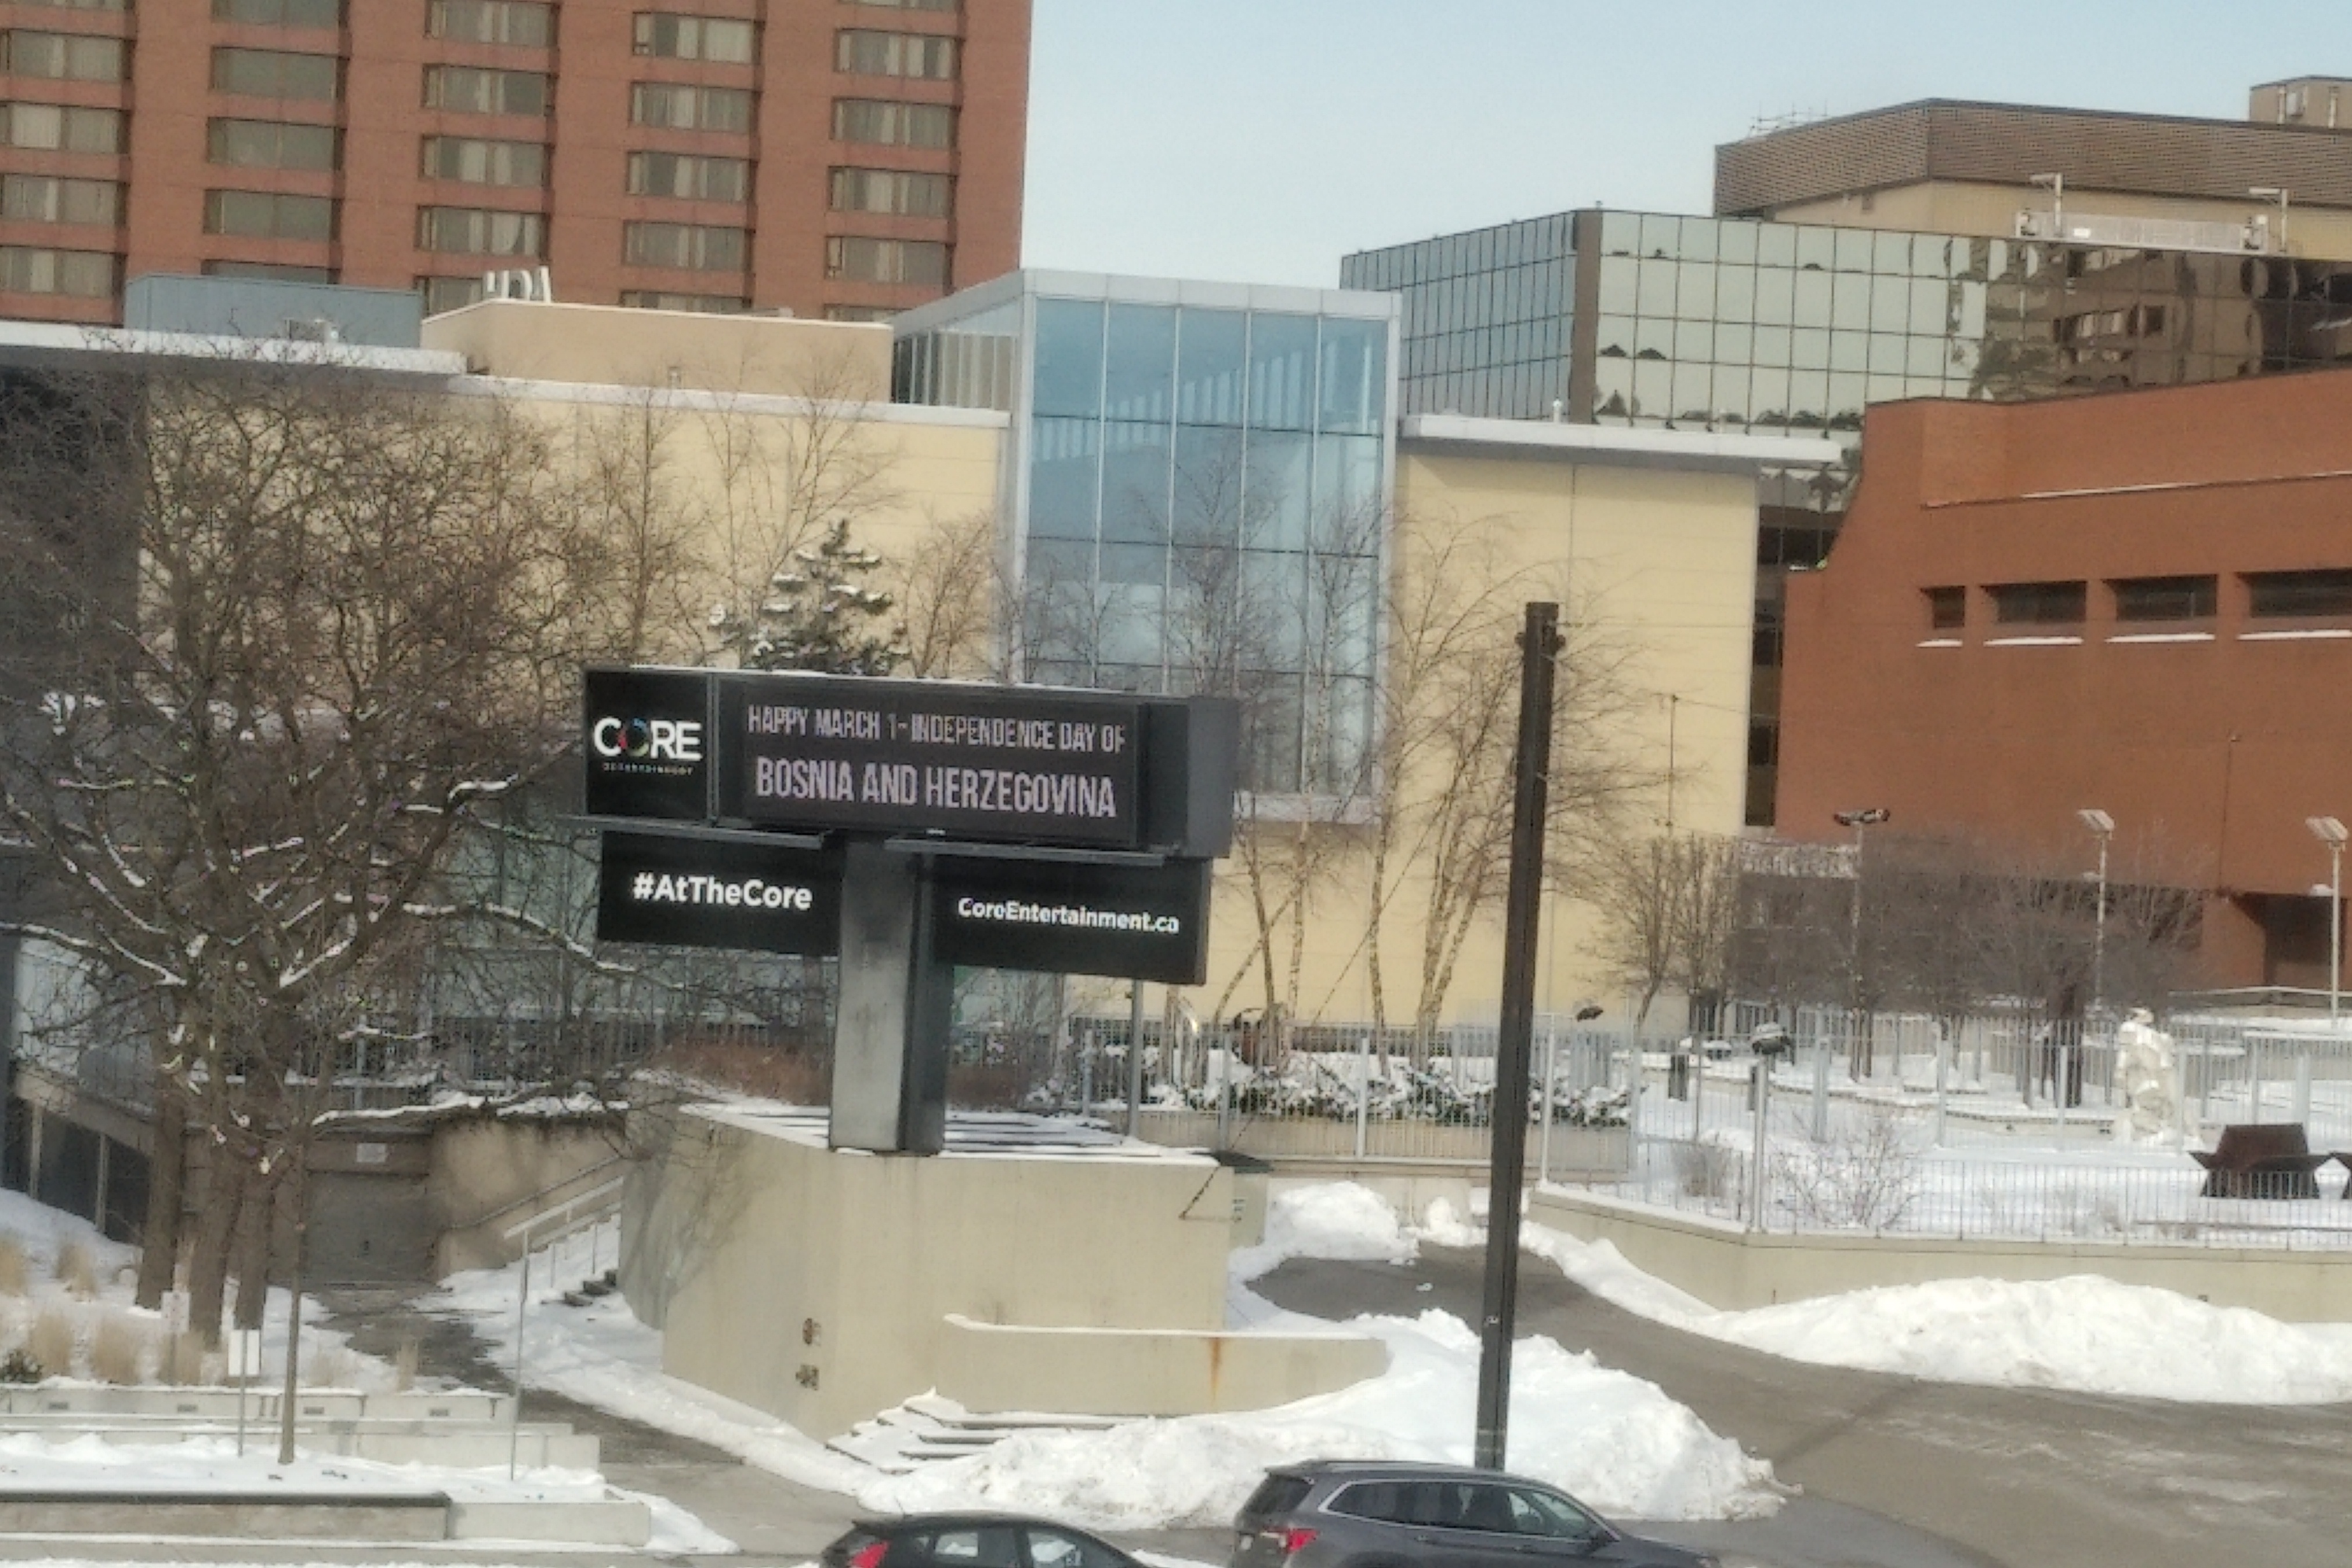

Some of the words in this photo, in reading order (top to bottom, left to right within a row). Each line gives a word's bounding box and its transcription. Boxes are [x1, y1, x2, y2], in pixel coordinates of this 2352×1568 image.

[594, 717, 703, 761] CORE
[749, 705, 808, 735] HAPPY
[815, 709, 881, 740] MARCH
[912, 713, 1055, 750] INDEPENDENCE
[1059, 722, 1095, 752] DAY
[1101, 725, 1125, 754] OF
[757, 756, 855, 801] BOSNIA
[863, 763, 917, 804] AND
[925, 767, 1116, 818] HERZEGOVINA
[633, 872, 812, 910] #AtTheCore
[958, 897, 1179, 934] CoreEntertainment.ca
